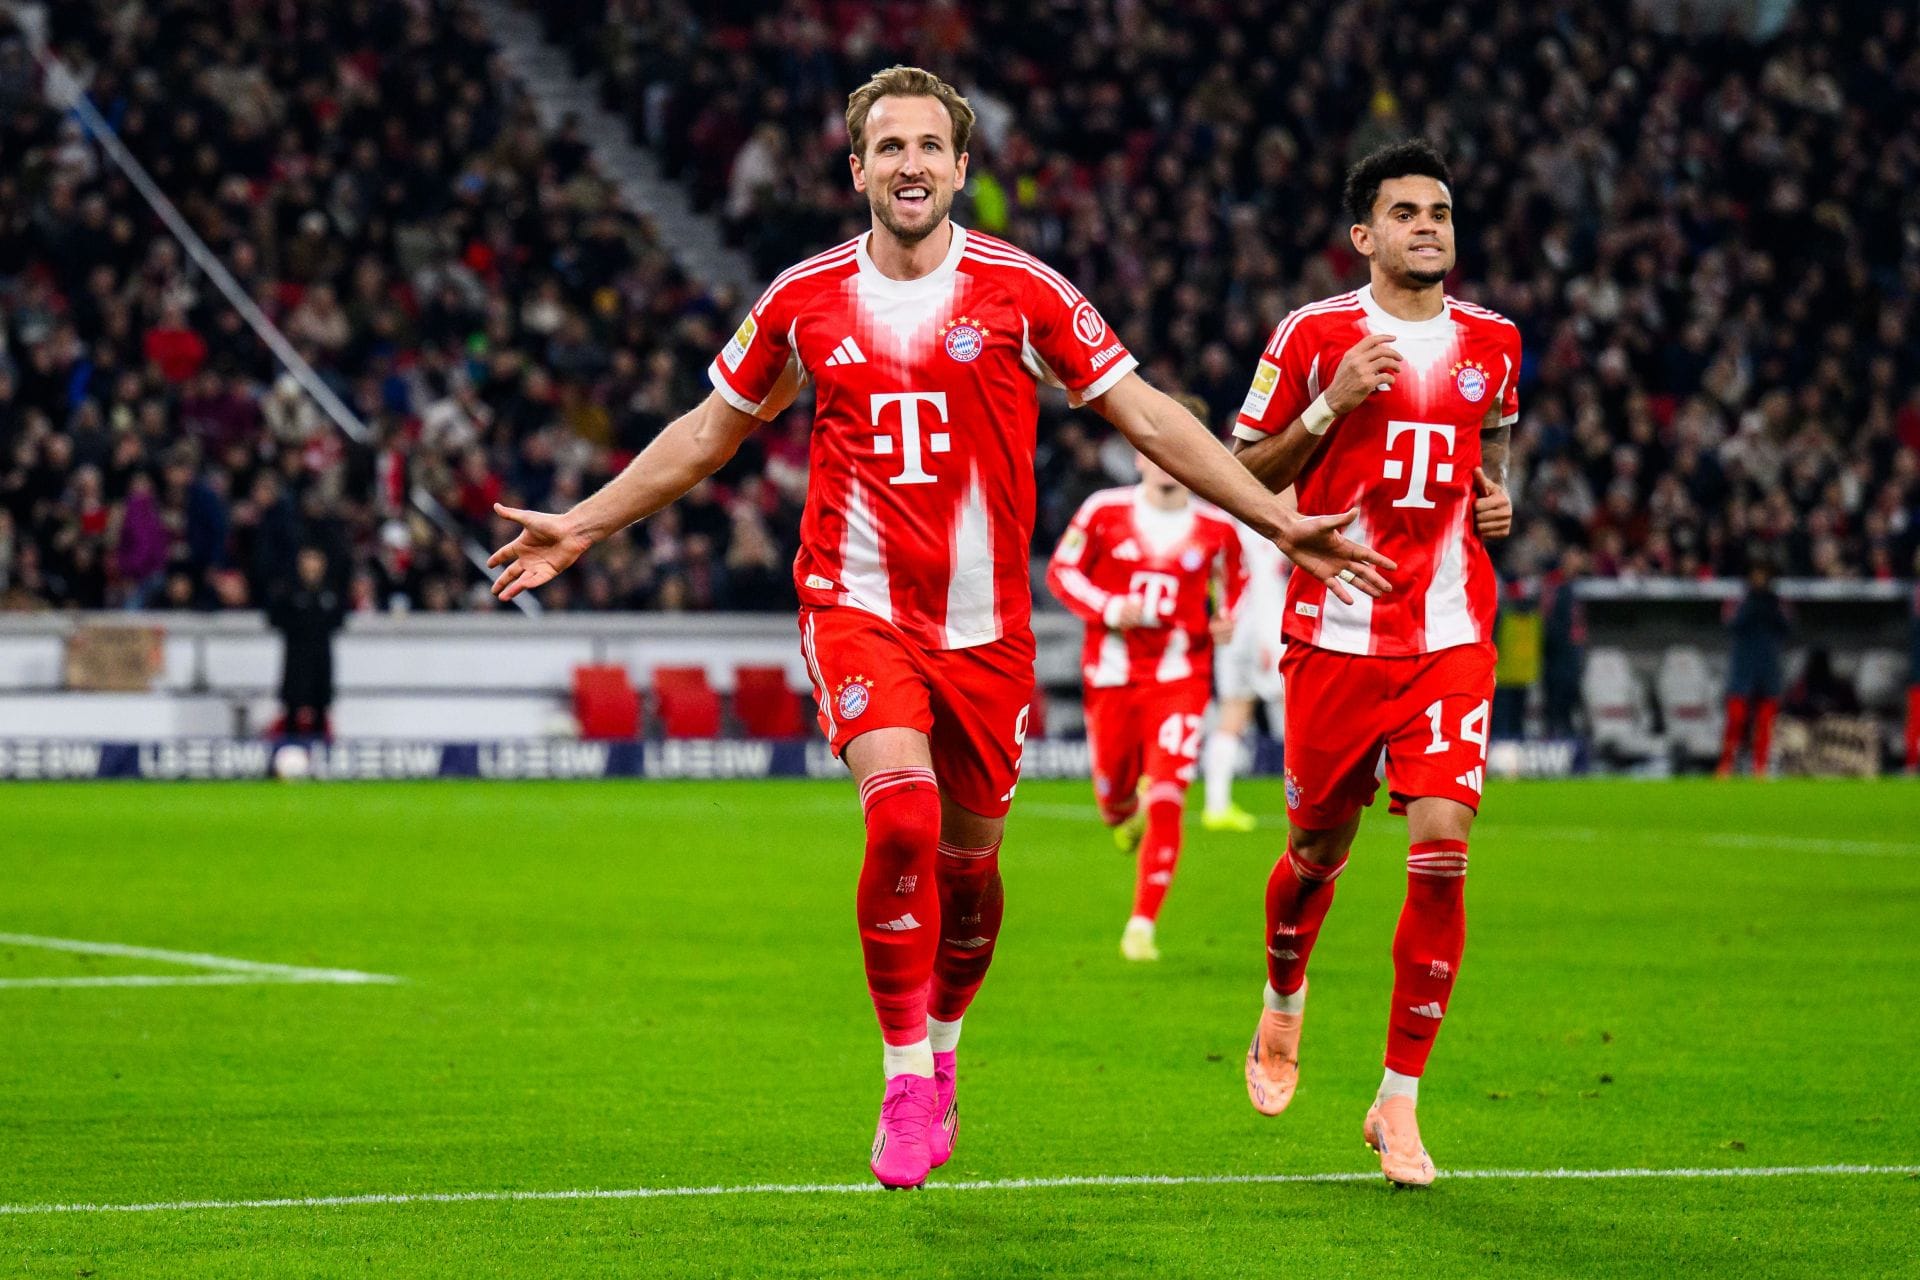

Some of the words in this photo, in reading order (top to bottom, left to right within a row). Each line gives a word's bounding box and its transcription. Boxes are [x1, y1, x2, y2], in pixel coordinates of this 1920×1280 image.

[950, 347, 979, 360] MÜNCHEN
[955, 328, 980, 342] BAYERN
[870, 391, 951, 485] T
[1383, 420, 1456, 509] T
[1158, 712, 1203, 759] 42
[1423, 698, 1489, 761] 14
